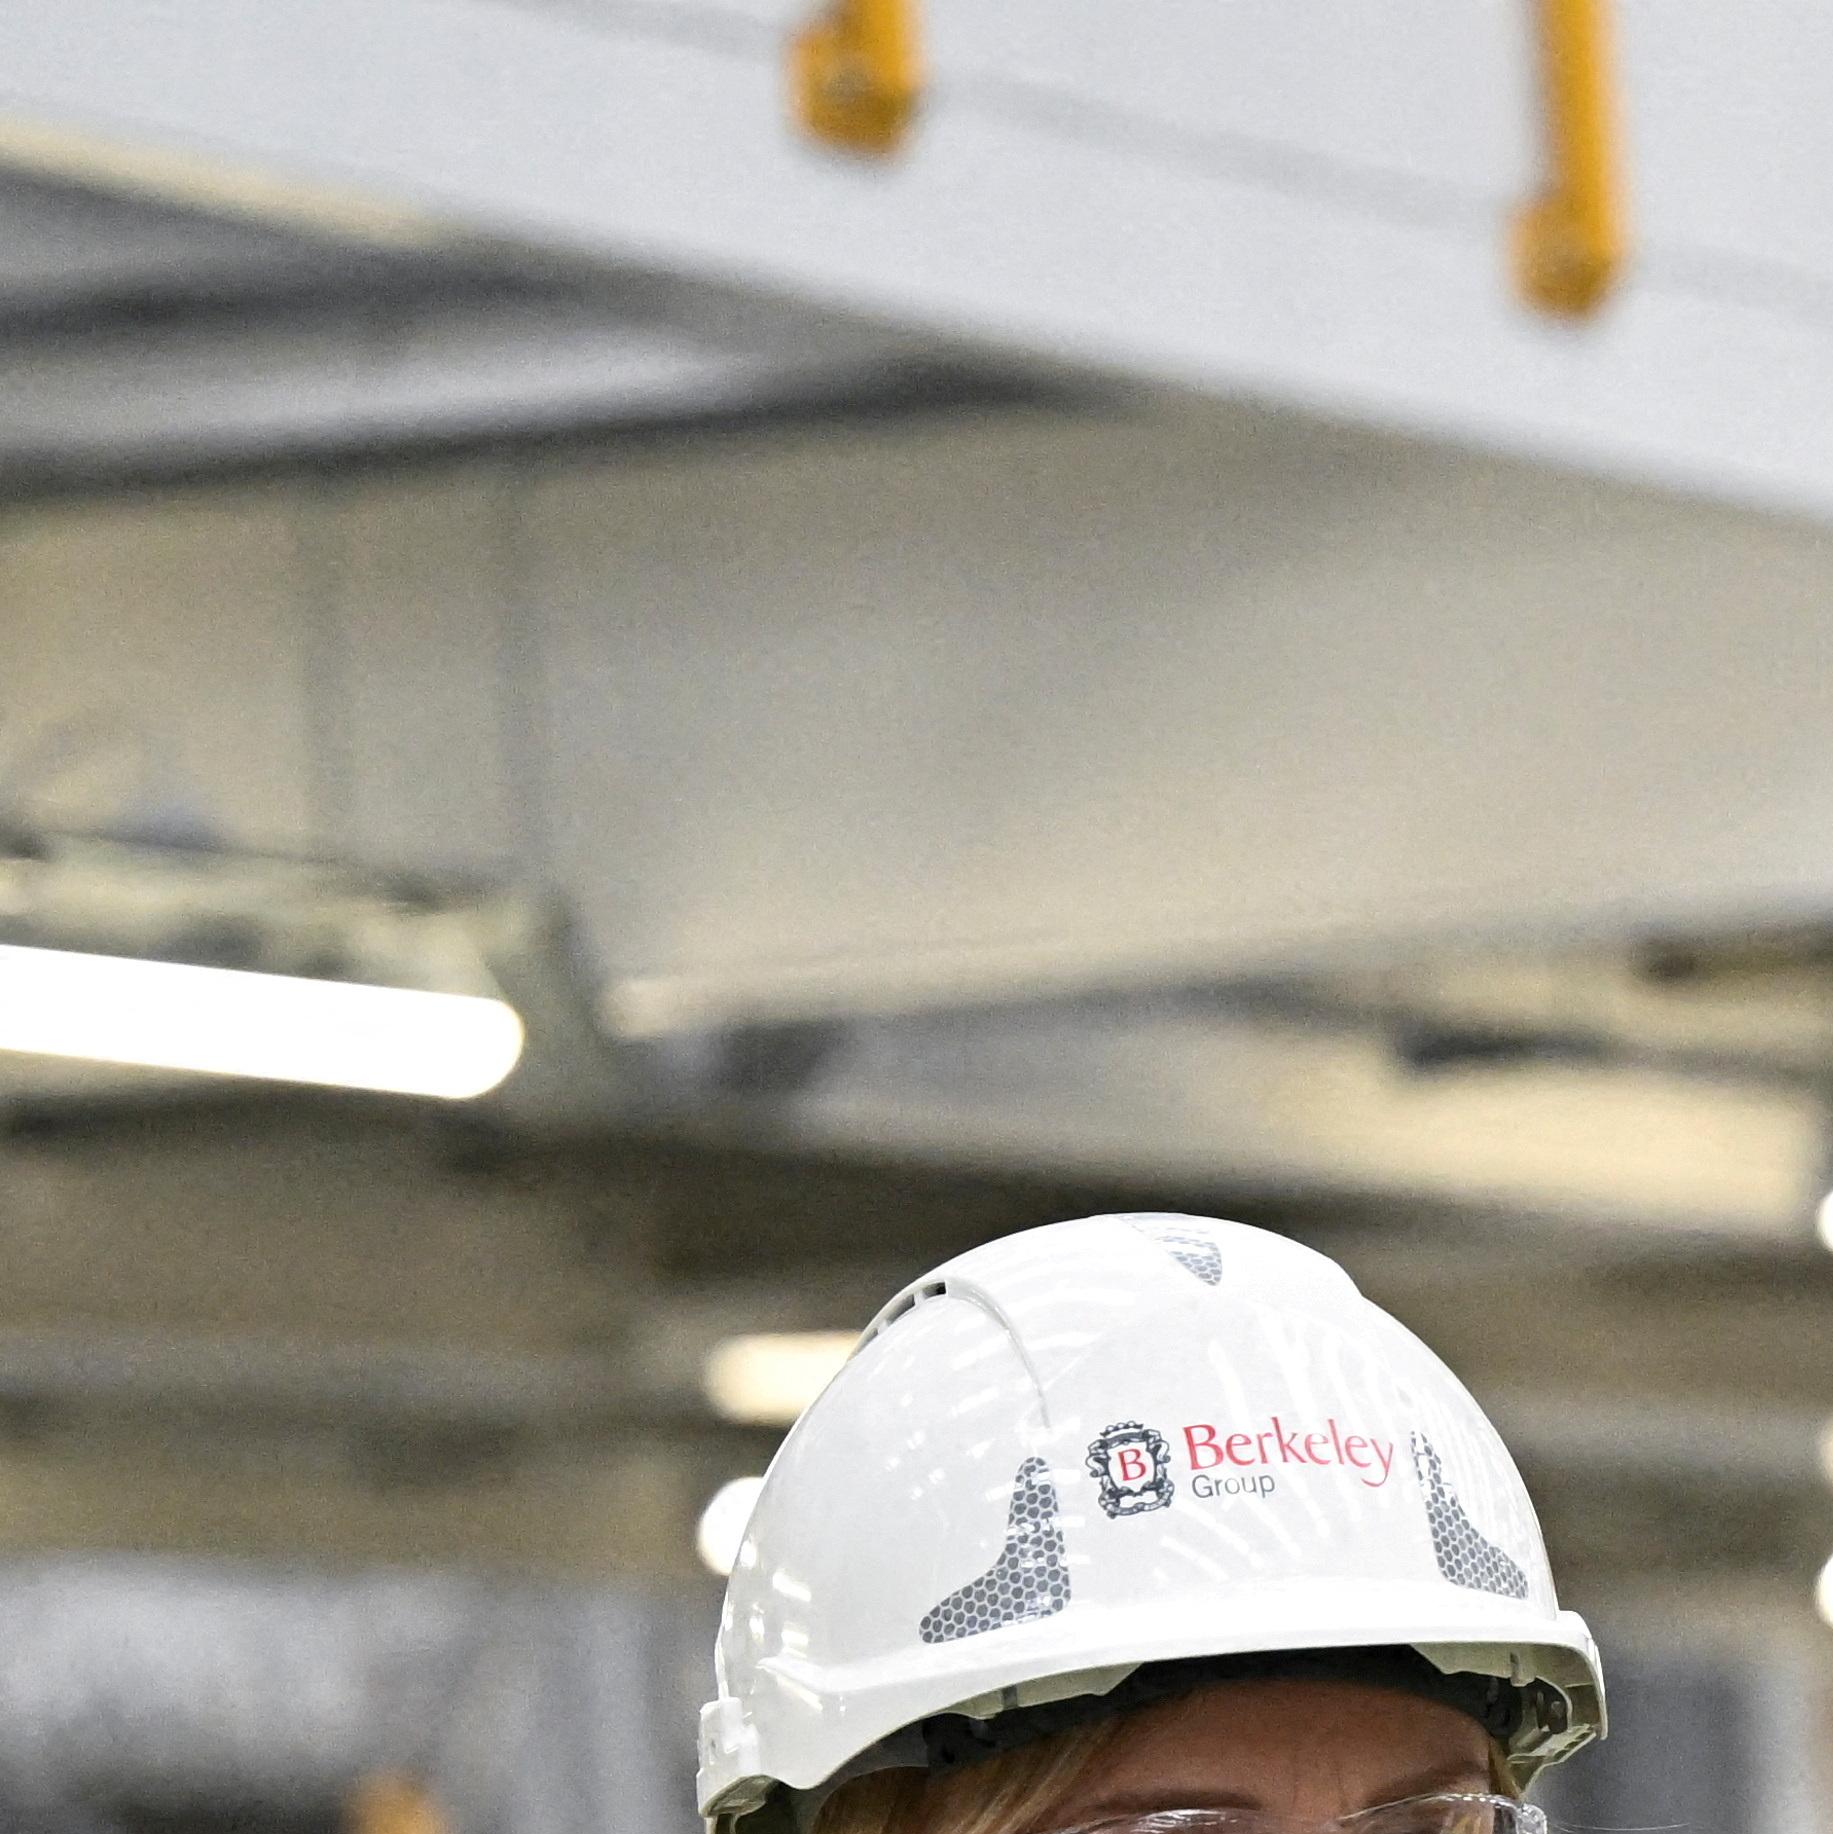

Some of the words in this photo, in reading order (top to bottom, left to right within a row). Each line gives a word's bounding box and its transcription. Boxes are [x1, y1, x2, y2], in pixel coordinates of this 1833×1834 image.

[1117, 1448, 1147, 1481] B
[1183, 1416, 1394, 1488] Berkeley
[1191, 1474, 1276, 1499] Group
